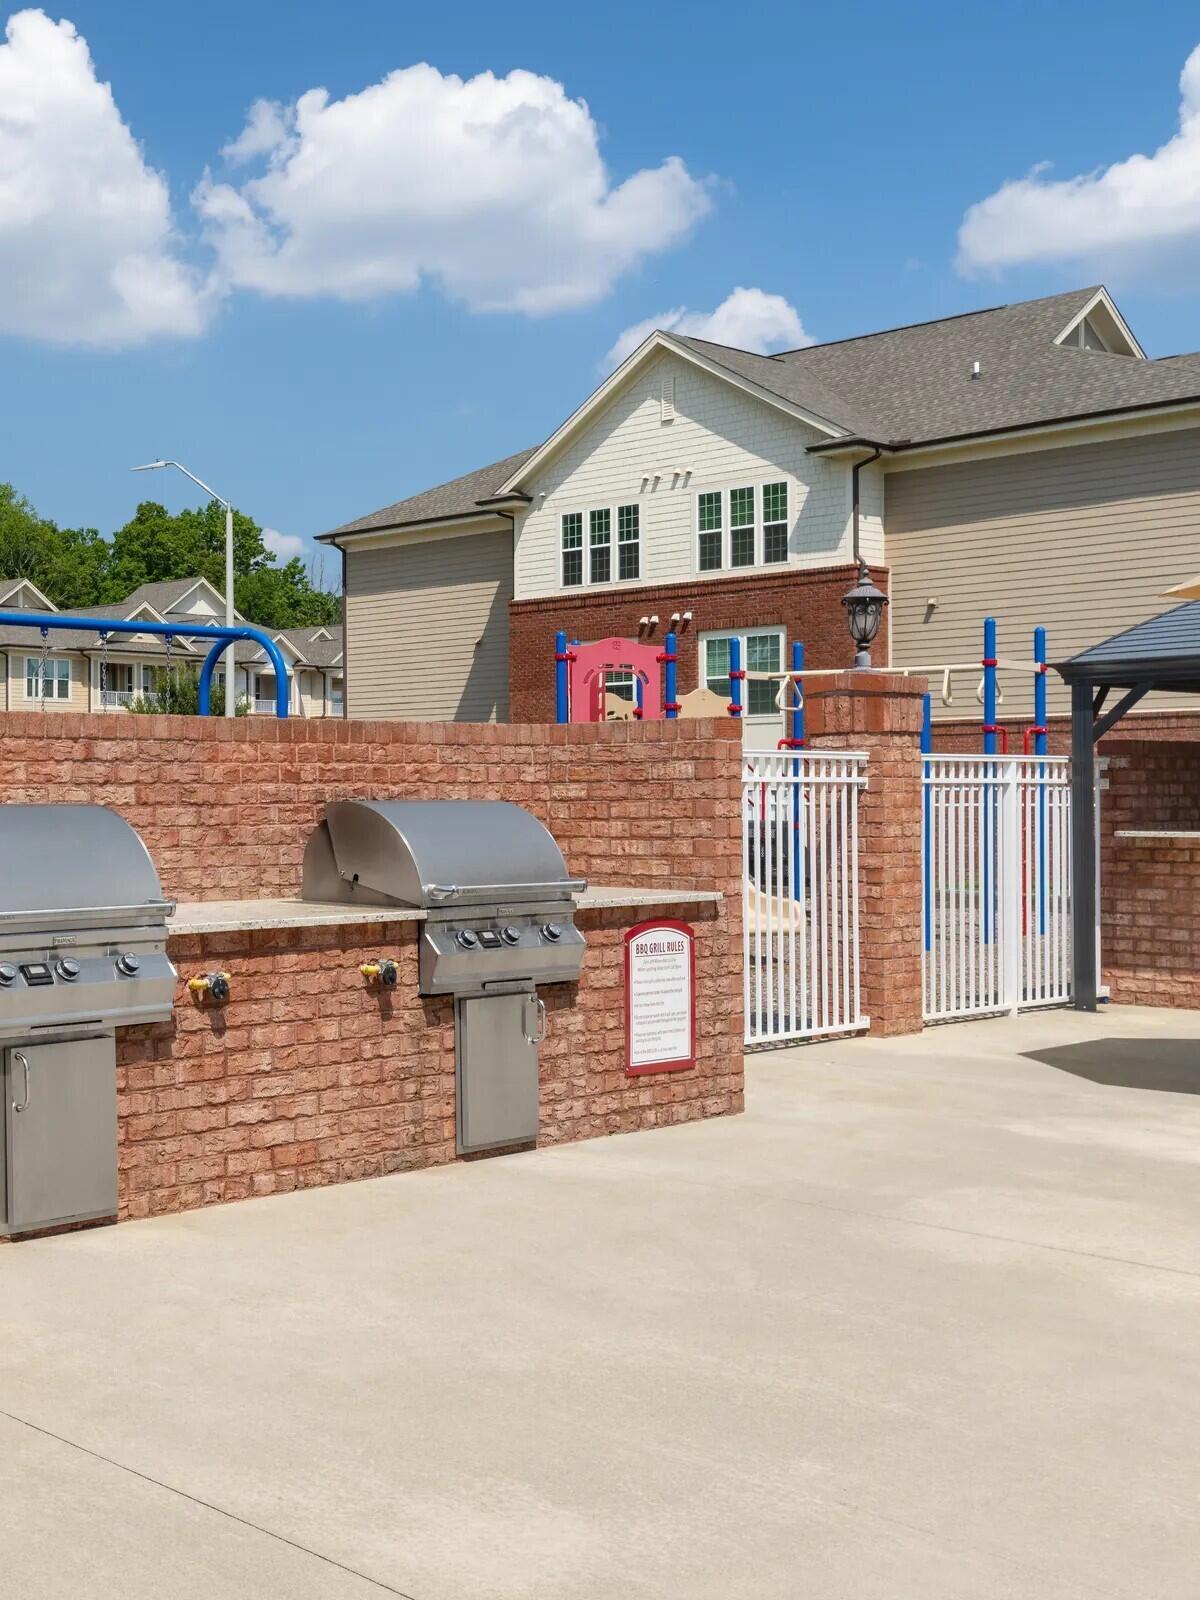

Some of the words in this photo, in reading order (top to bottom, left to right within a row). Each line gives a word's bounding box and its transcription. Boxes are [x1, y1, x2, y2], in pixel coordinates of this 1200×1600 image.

[635, 943, 649, 955] BBQ
[649, 942, 666, 954] GRILL
[667, 940, 685, 952] RULES
